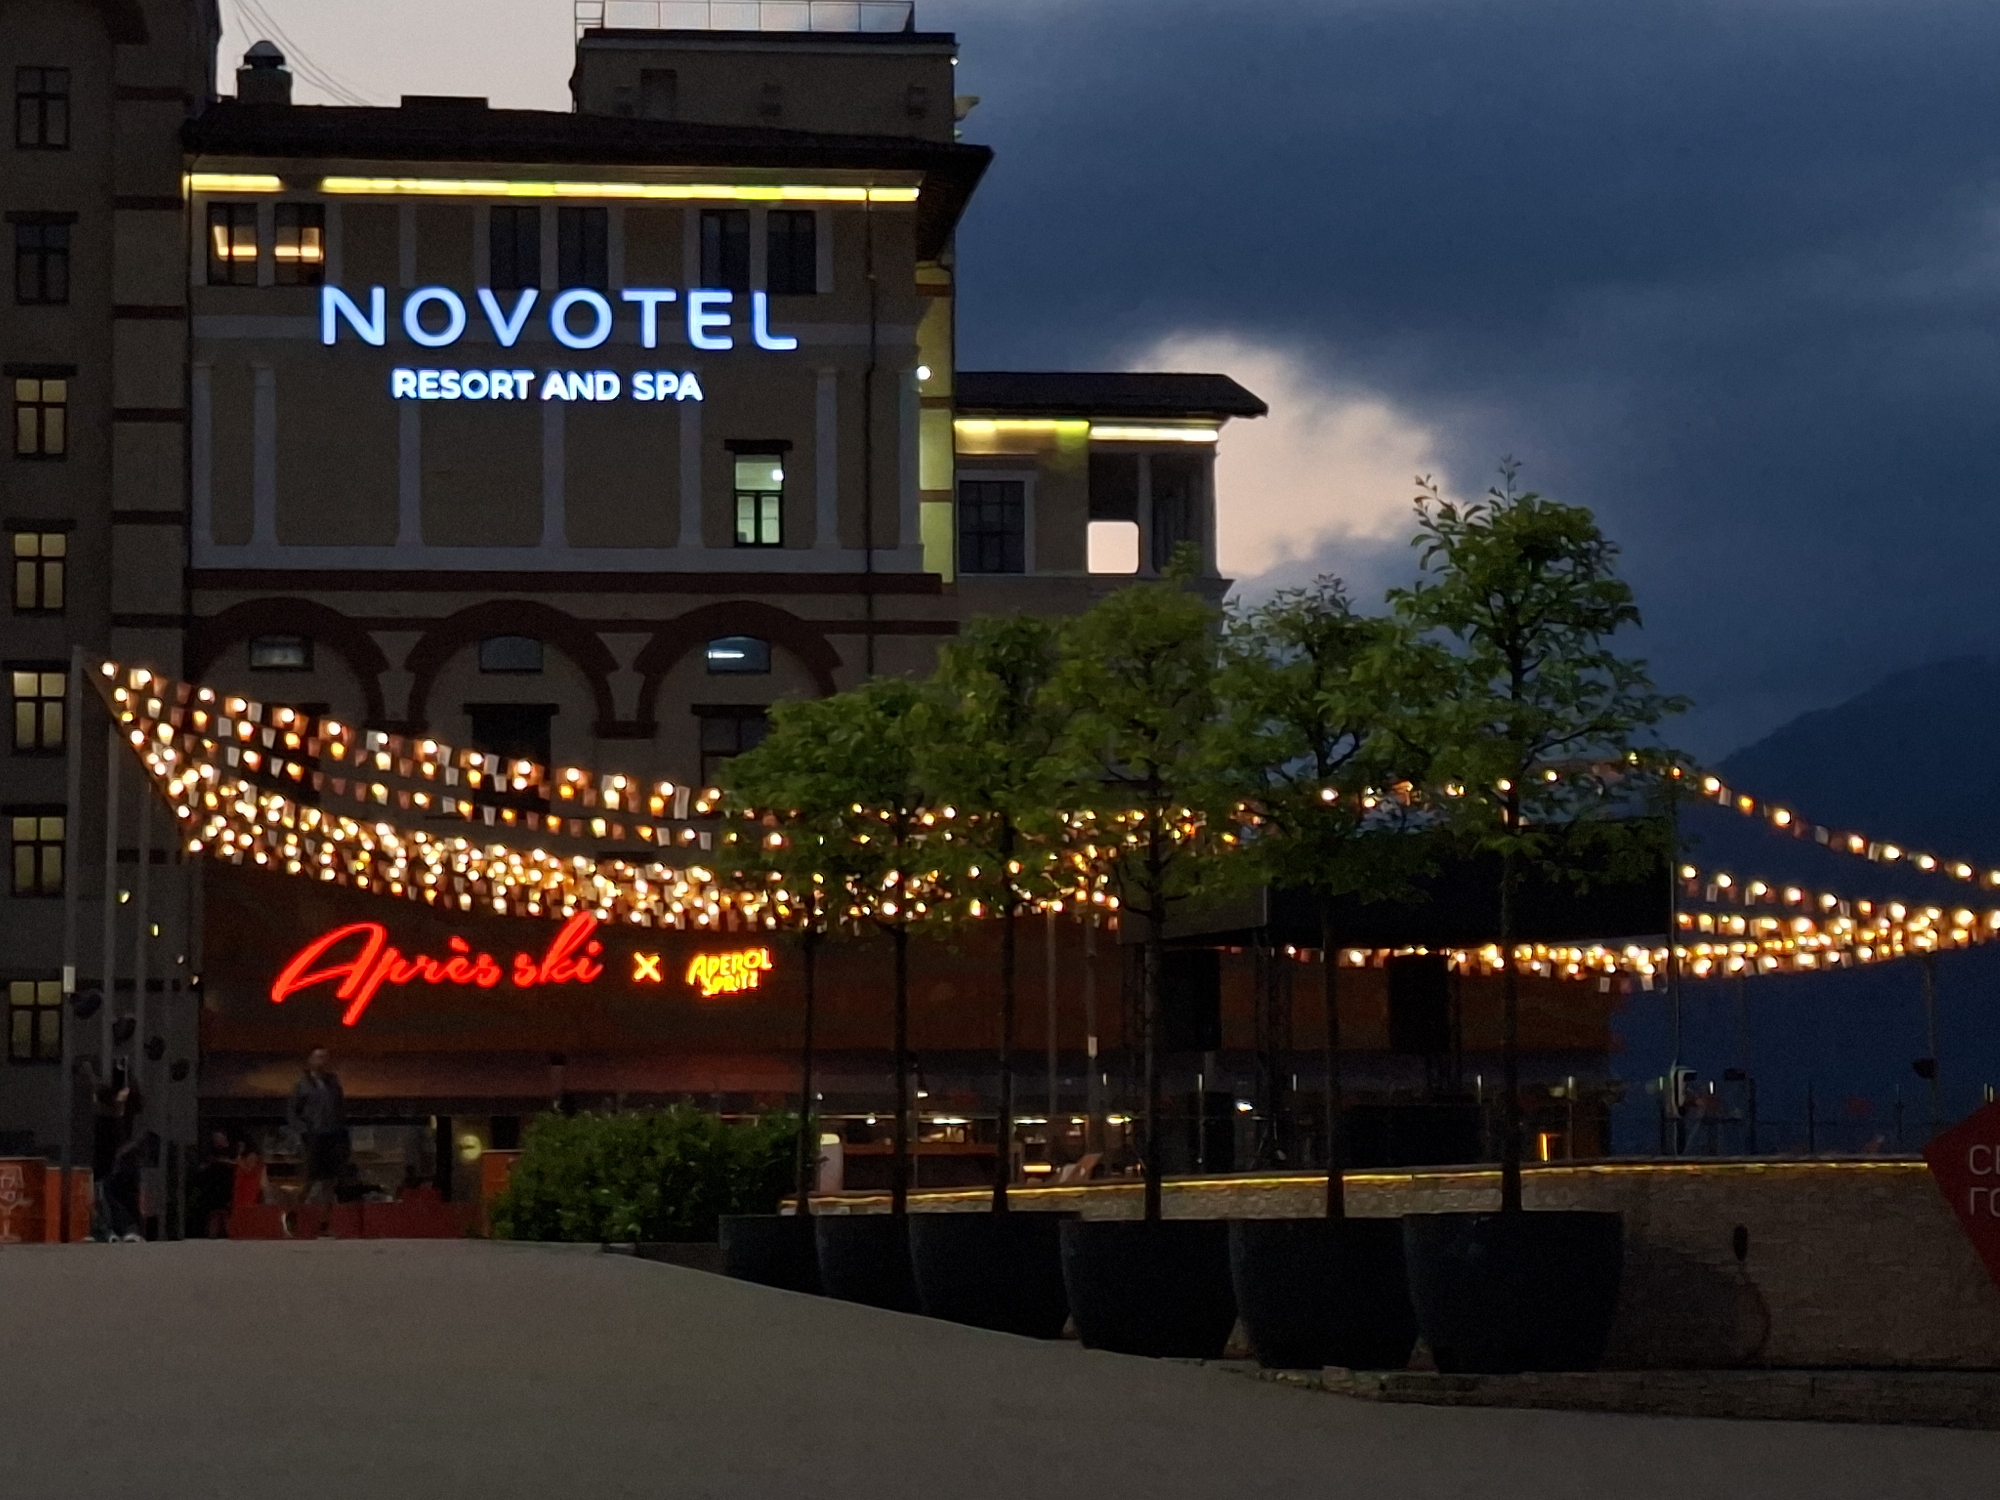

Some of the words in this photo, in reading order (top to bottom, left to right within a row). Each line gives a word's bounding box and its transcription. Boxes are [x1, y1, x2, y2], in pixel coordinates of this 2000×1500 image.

[320, 285, 799, 351] NOVOTEL
[390, 368, 535, 401] RESORT
[541, 370, 621, 400] AND
[632, 372, 705, 402] SPA
[270, 921, 501, 1027] Après
[512, 911, 605, 988] ski
[686, 947, 772, 985] APEROL
